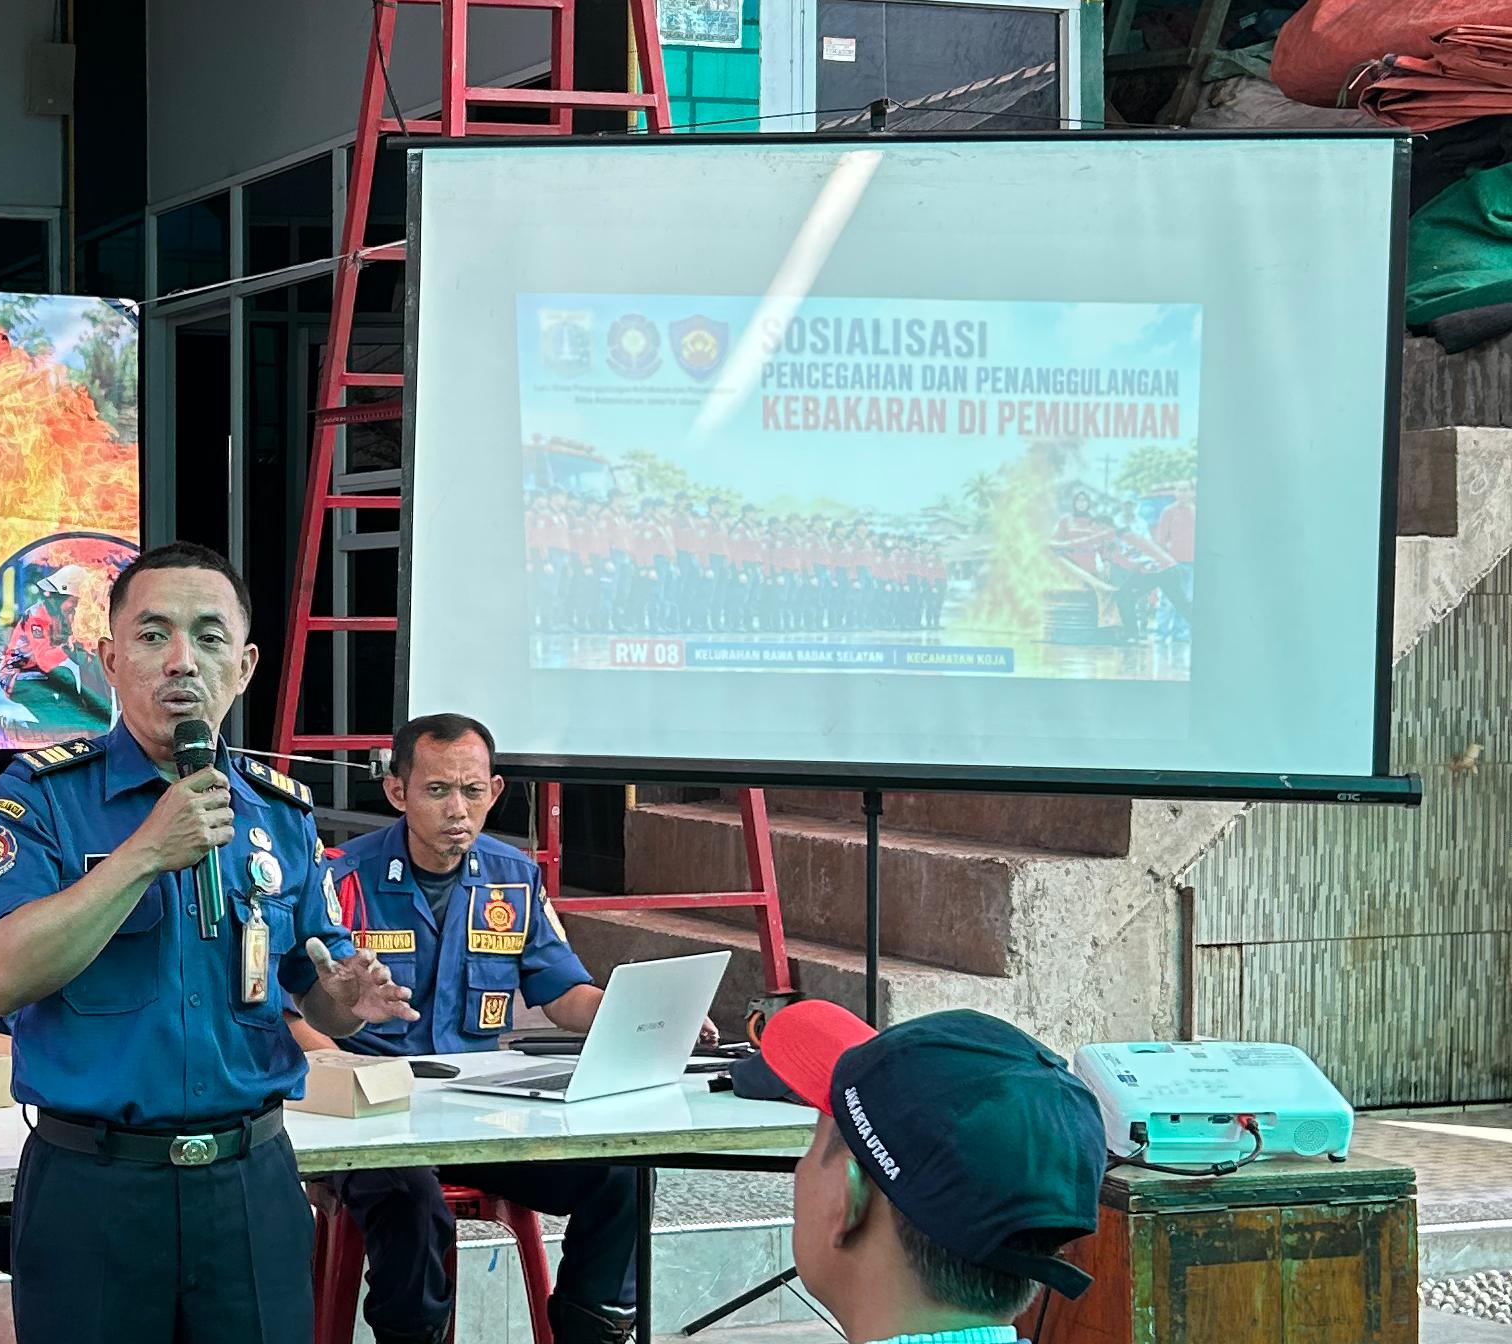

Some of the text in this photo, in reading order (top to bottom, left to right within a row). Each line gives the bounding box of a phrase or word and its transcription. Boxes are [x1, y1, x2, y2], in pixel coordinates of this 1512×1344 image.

[760, 313, 988, 359] SOSIALISASI
[760, 362, 1180, 397] PENCEGAHAN DAN PENANGGULANGAN
[761, 395, 1181, 440] KEBAKARAN DI PEMUKIMAN
[614, 643, 681, 665] RW 08
[836, 649, 884, 664] SELATAN
[844, 1086, 901, 1181] JAKARTA UTARA
